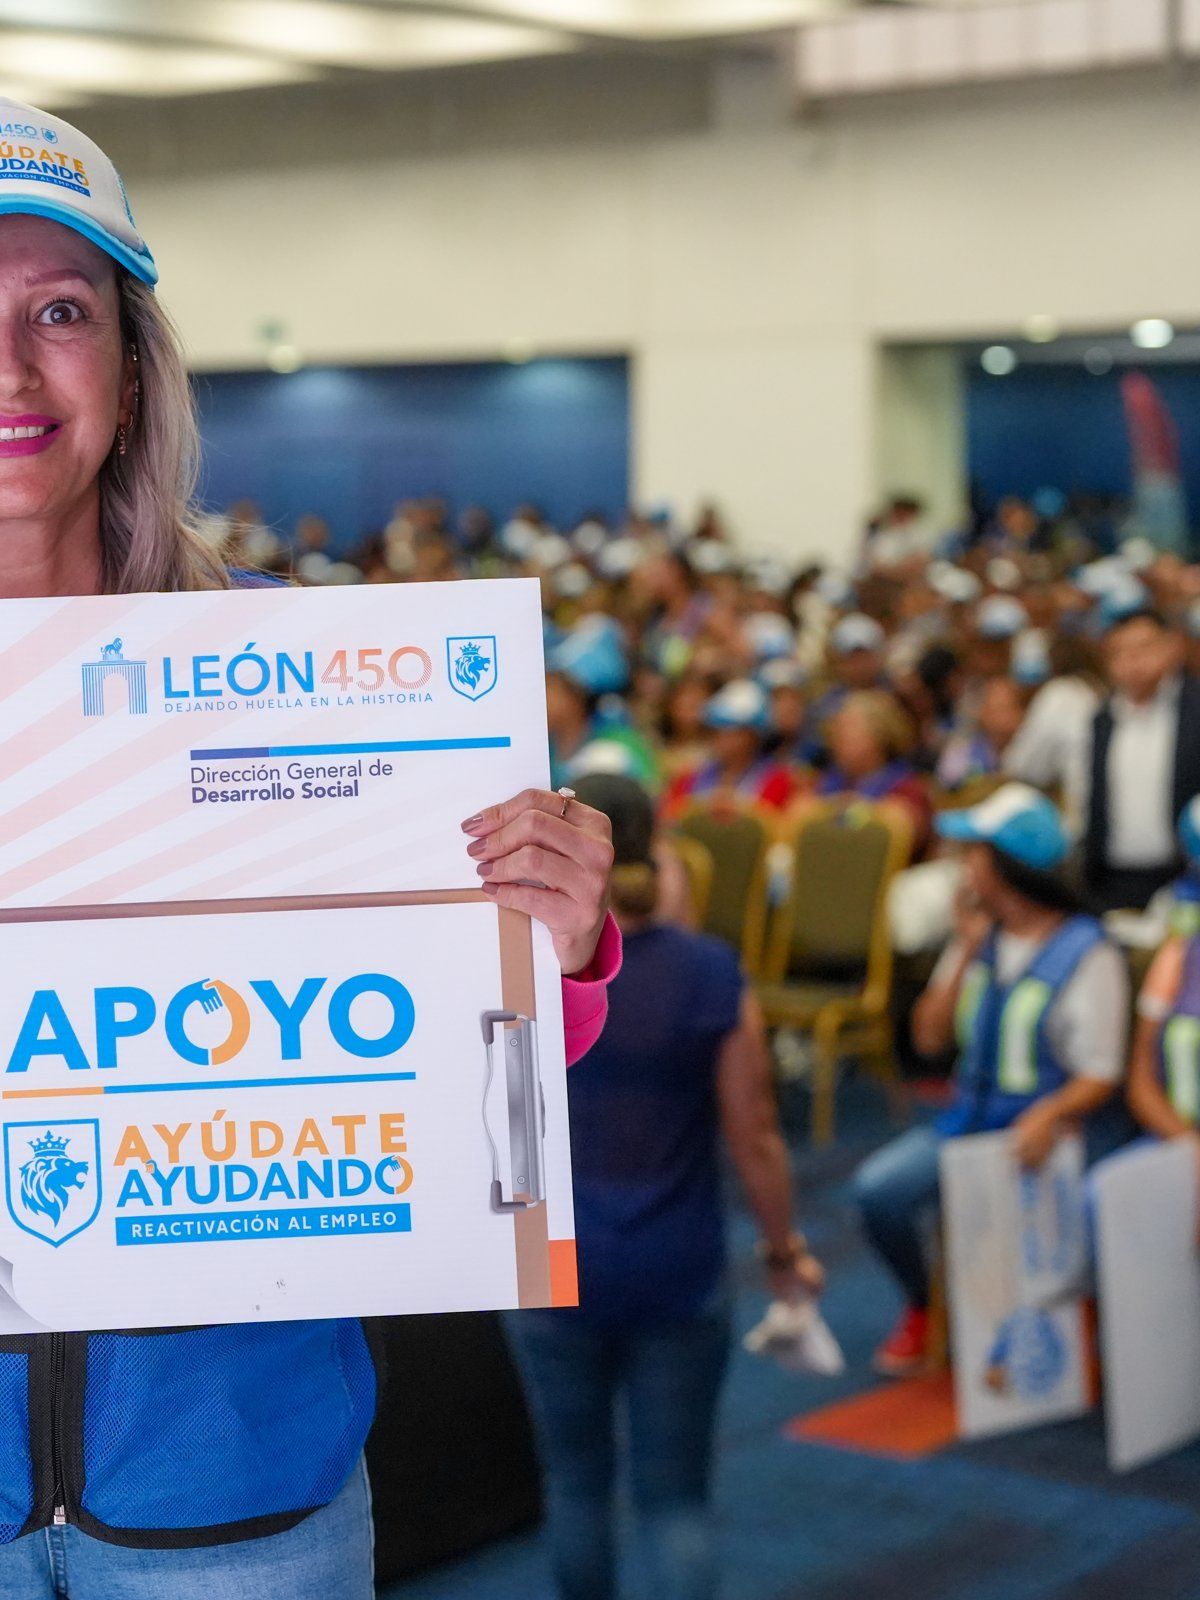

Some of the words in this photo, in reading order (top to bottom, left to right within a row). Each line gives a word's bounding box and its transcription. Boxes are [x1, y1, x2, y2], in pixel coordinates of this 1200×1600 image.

[165, 701, 238, 713] DEJANDO
[246, 698, 302, 710] HUELLA
[311, 697, 329, 707] EN
[337, 696, 355, 706] LA
[362, 693, 433, 705] HISTORIA
[191, 764, 281, 784] Dirección
[287, 760, 362, 781] General
[368, 759, 393, 778] de
[191, 782, 295, 804] Desarrollo
[301, 780, 359, 799] Social
[5, 973, 416, 1073] APOYO
[113, 1109, 408, 1166] AYÚDATE
[116, 1155, 414, 1208] AYUDANDO
[131, 1213, 280, 1239] REACTIVACIÓN
[288, 1215, 312, 1231] AL
[319, 1211, 397, 1229] EMPLEO
